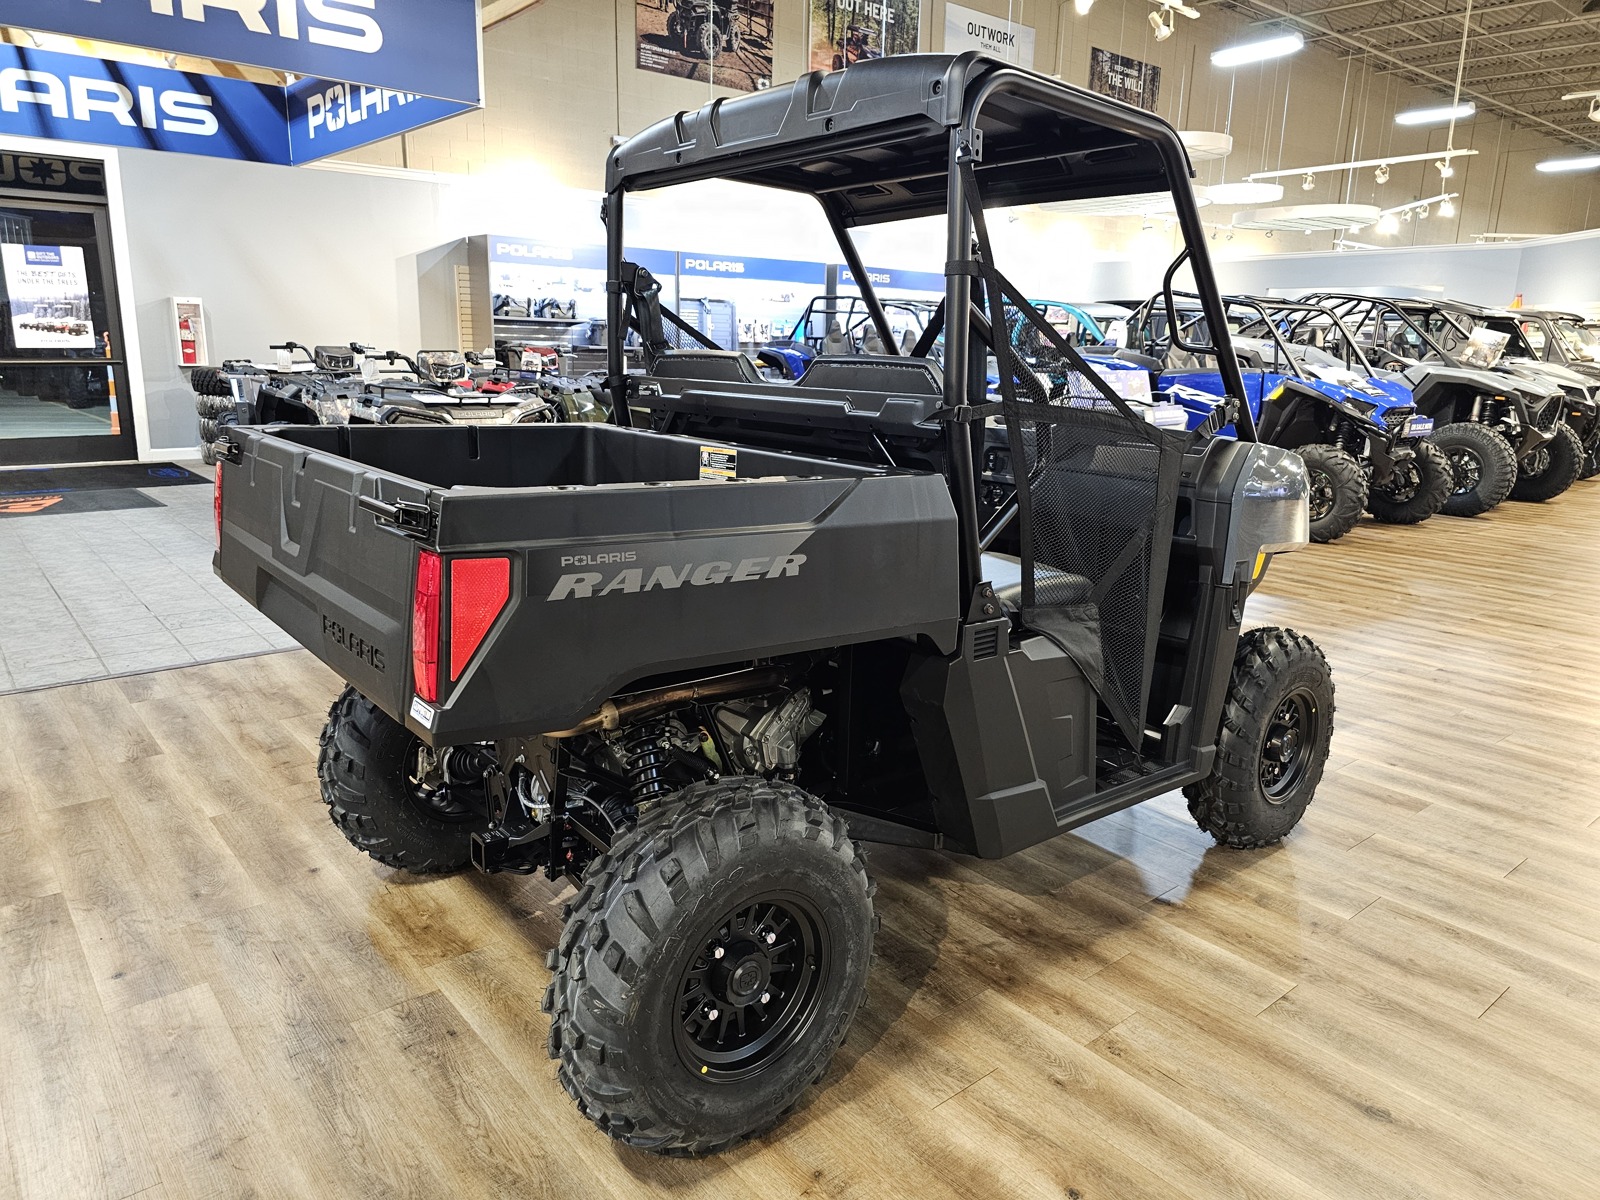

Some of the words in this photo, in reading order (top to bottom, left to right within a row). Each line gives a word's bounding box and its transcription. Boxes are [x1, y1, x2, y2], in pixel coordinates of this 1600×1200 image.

[837, 0, 860, 13] OUT
[864, 0, 895, 24] HERE
[967, 21, 1015, 48] OUTWORK
[980, 41, 993, 51] THEM
[992, 45, 1002, 54] ALL
[1108, 72, 1124, 88] THE
[1124, 76, 1144, 93] WILD
[496, 242, 574, 261] POLARIS
[684, 258, 746, 274] POLARIS
[560, 551, 637, 567] POLARIS
[546, 553, 808, 602] RANGER
[322, 613, 386, 674] POLARIS
